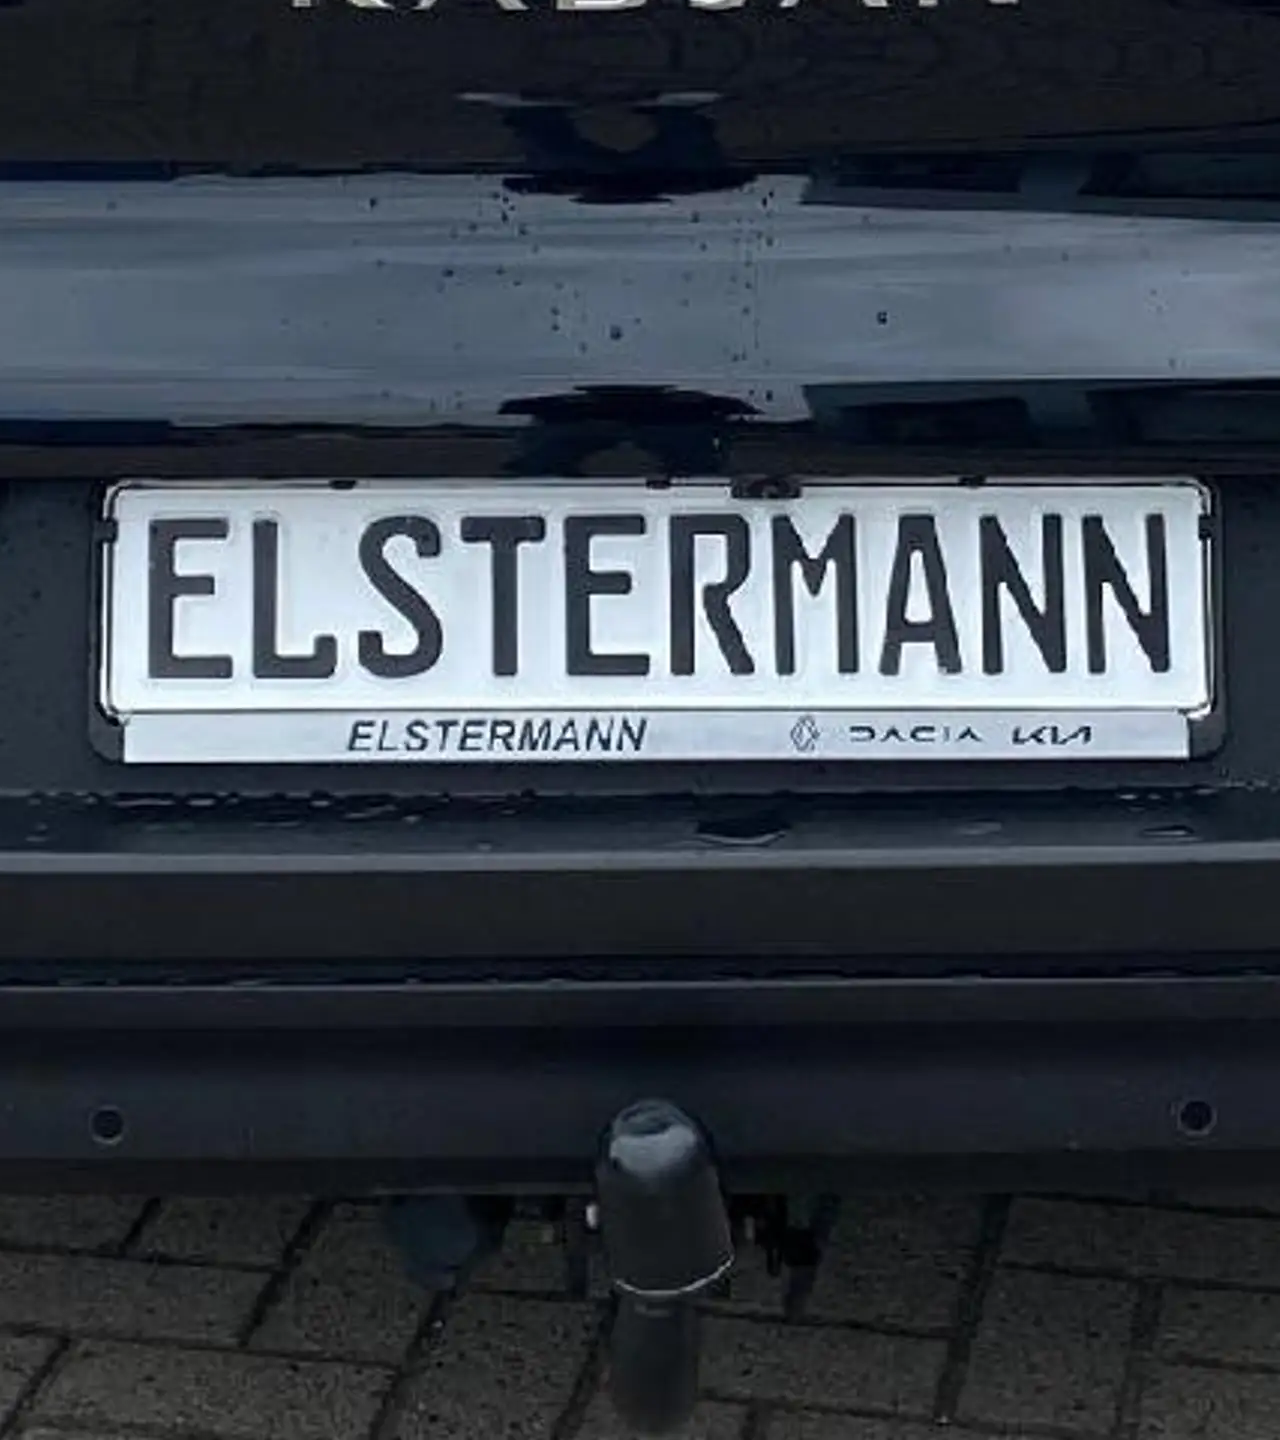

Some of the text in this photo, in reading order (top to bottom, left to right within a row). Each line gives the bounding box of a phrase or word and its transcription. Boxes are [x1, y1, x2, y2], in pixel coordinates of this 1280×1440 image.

[147, 513, 1172, 680] ELSTERMANN
[346, 717, 648, 752] ELSTERMANN
[849, 725, 1092, 745] DACIA KIA
